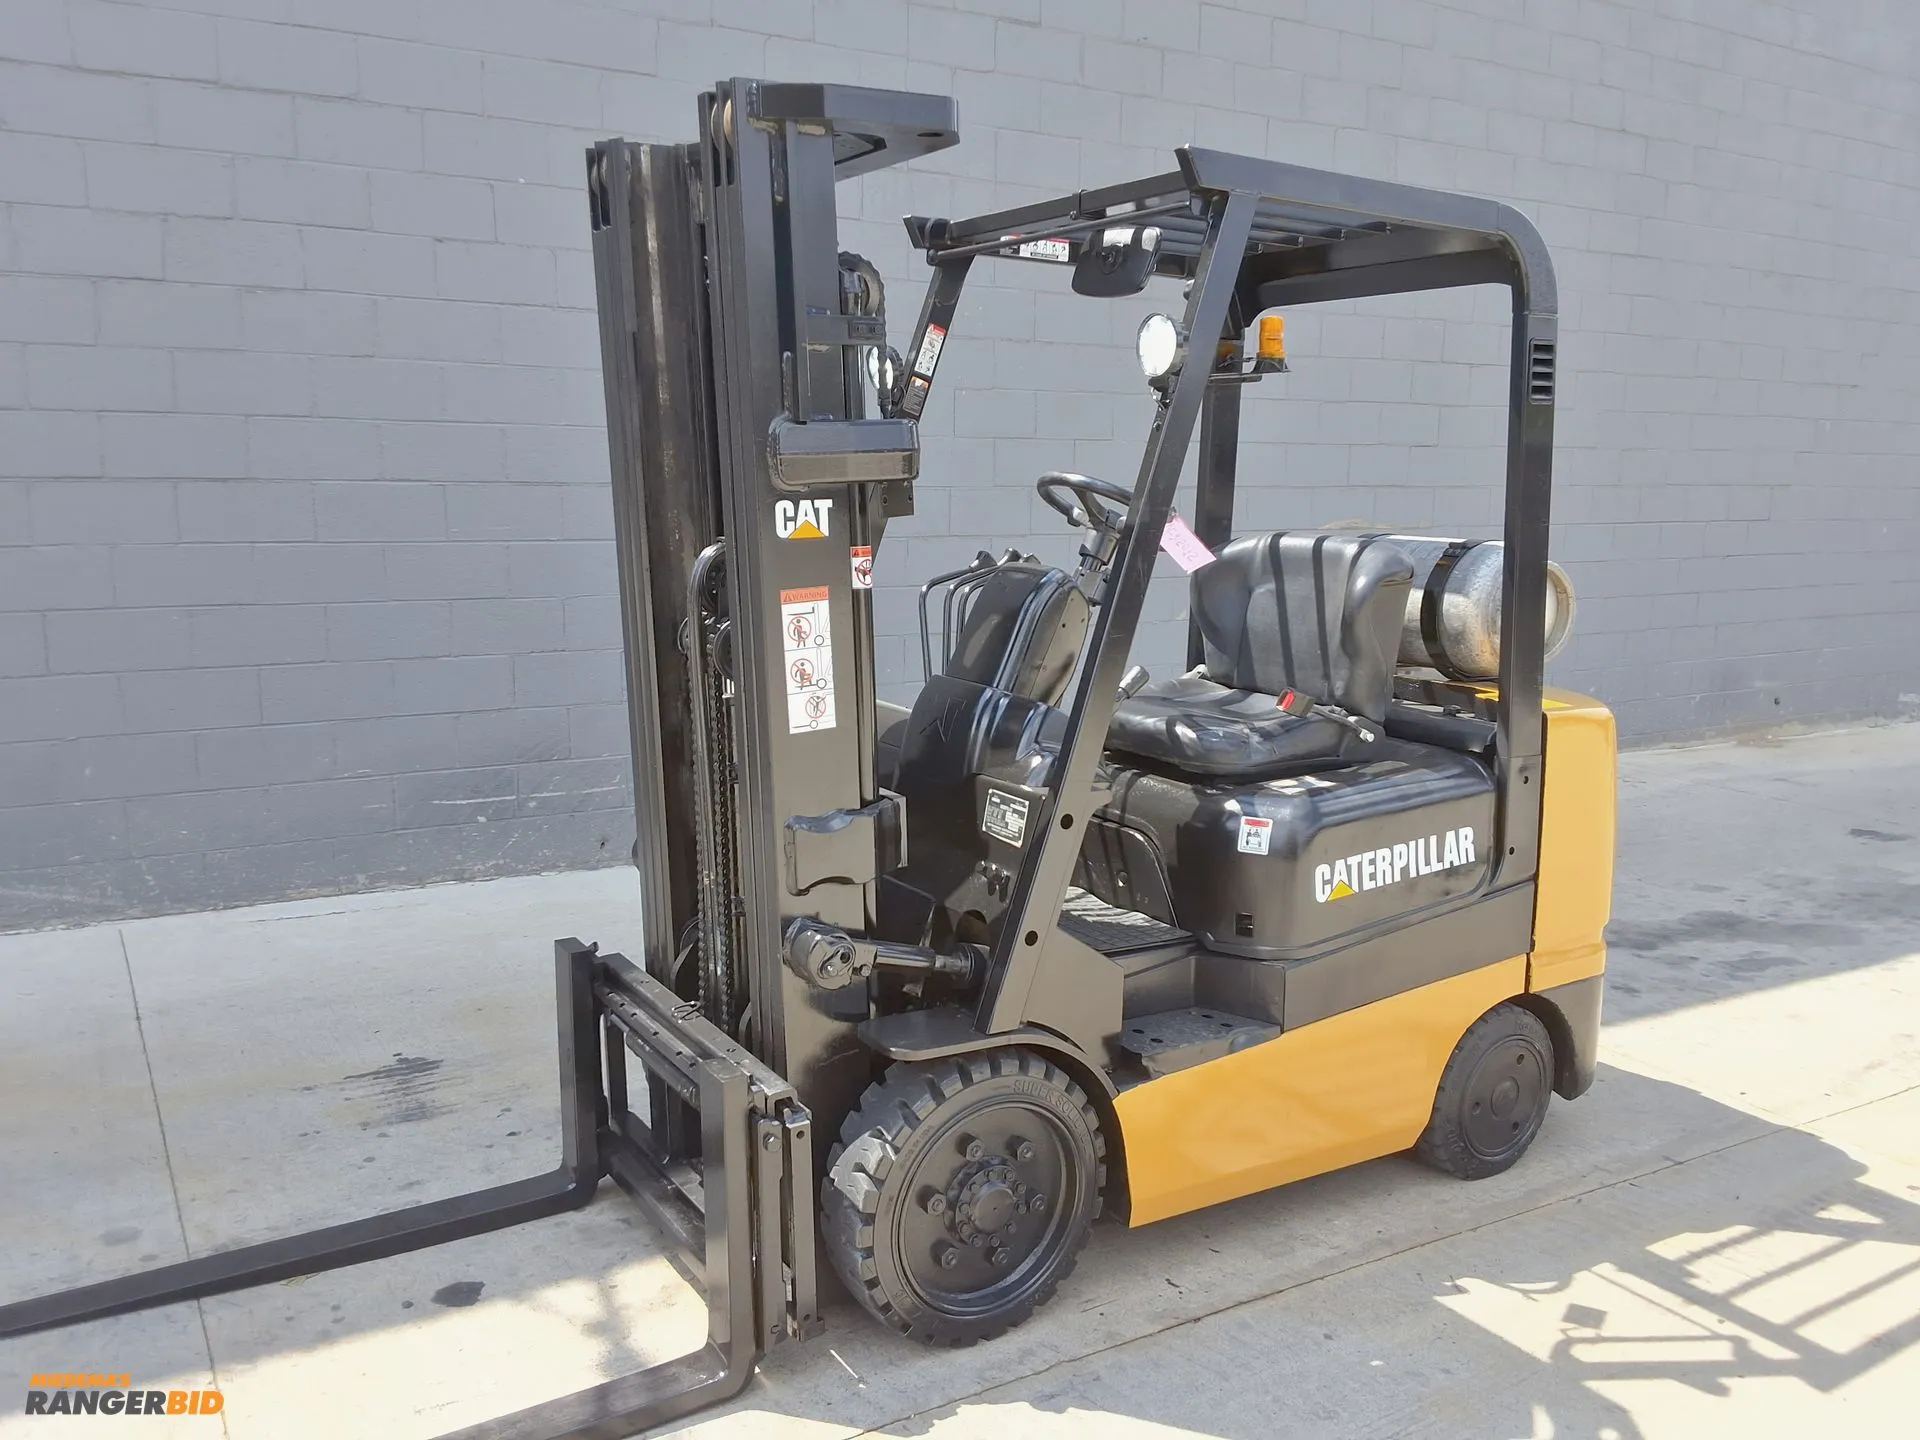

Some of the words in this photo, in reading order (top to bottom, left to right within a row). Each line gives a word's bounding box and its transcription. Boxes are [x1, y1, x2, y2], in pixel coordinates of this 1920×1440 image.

[775, 499, 832, 539] CAT
[791, 591, 827, 601] WARNING
[1315, 827, 1476, 903] CATERPILLAR
